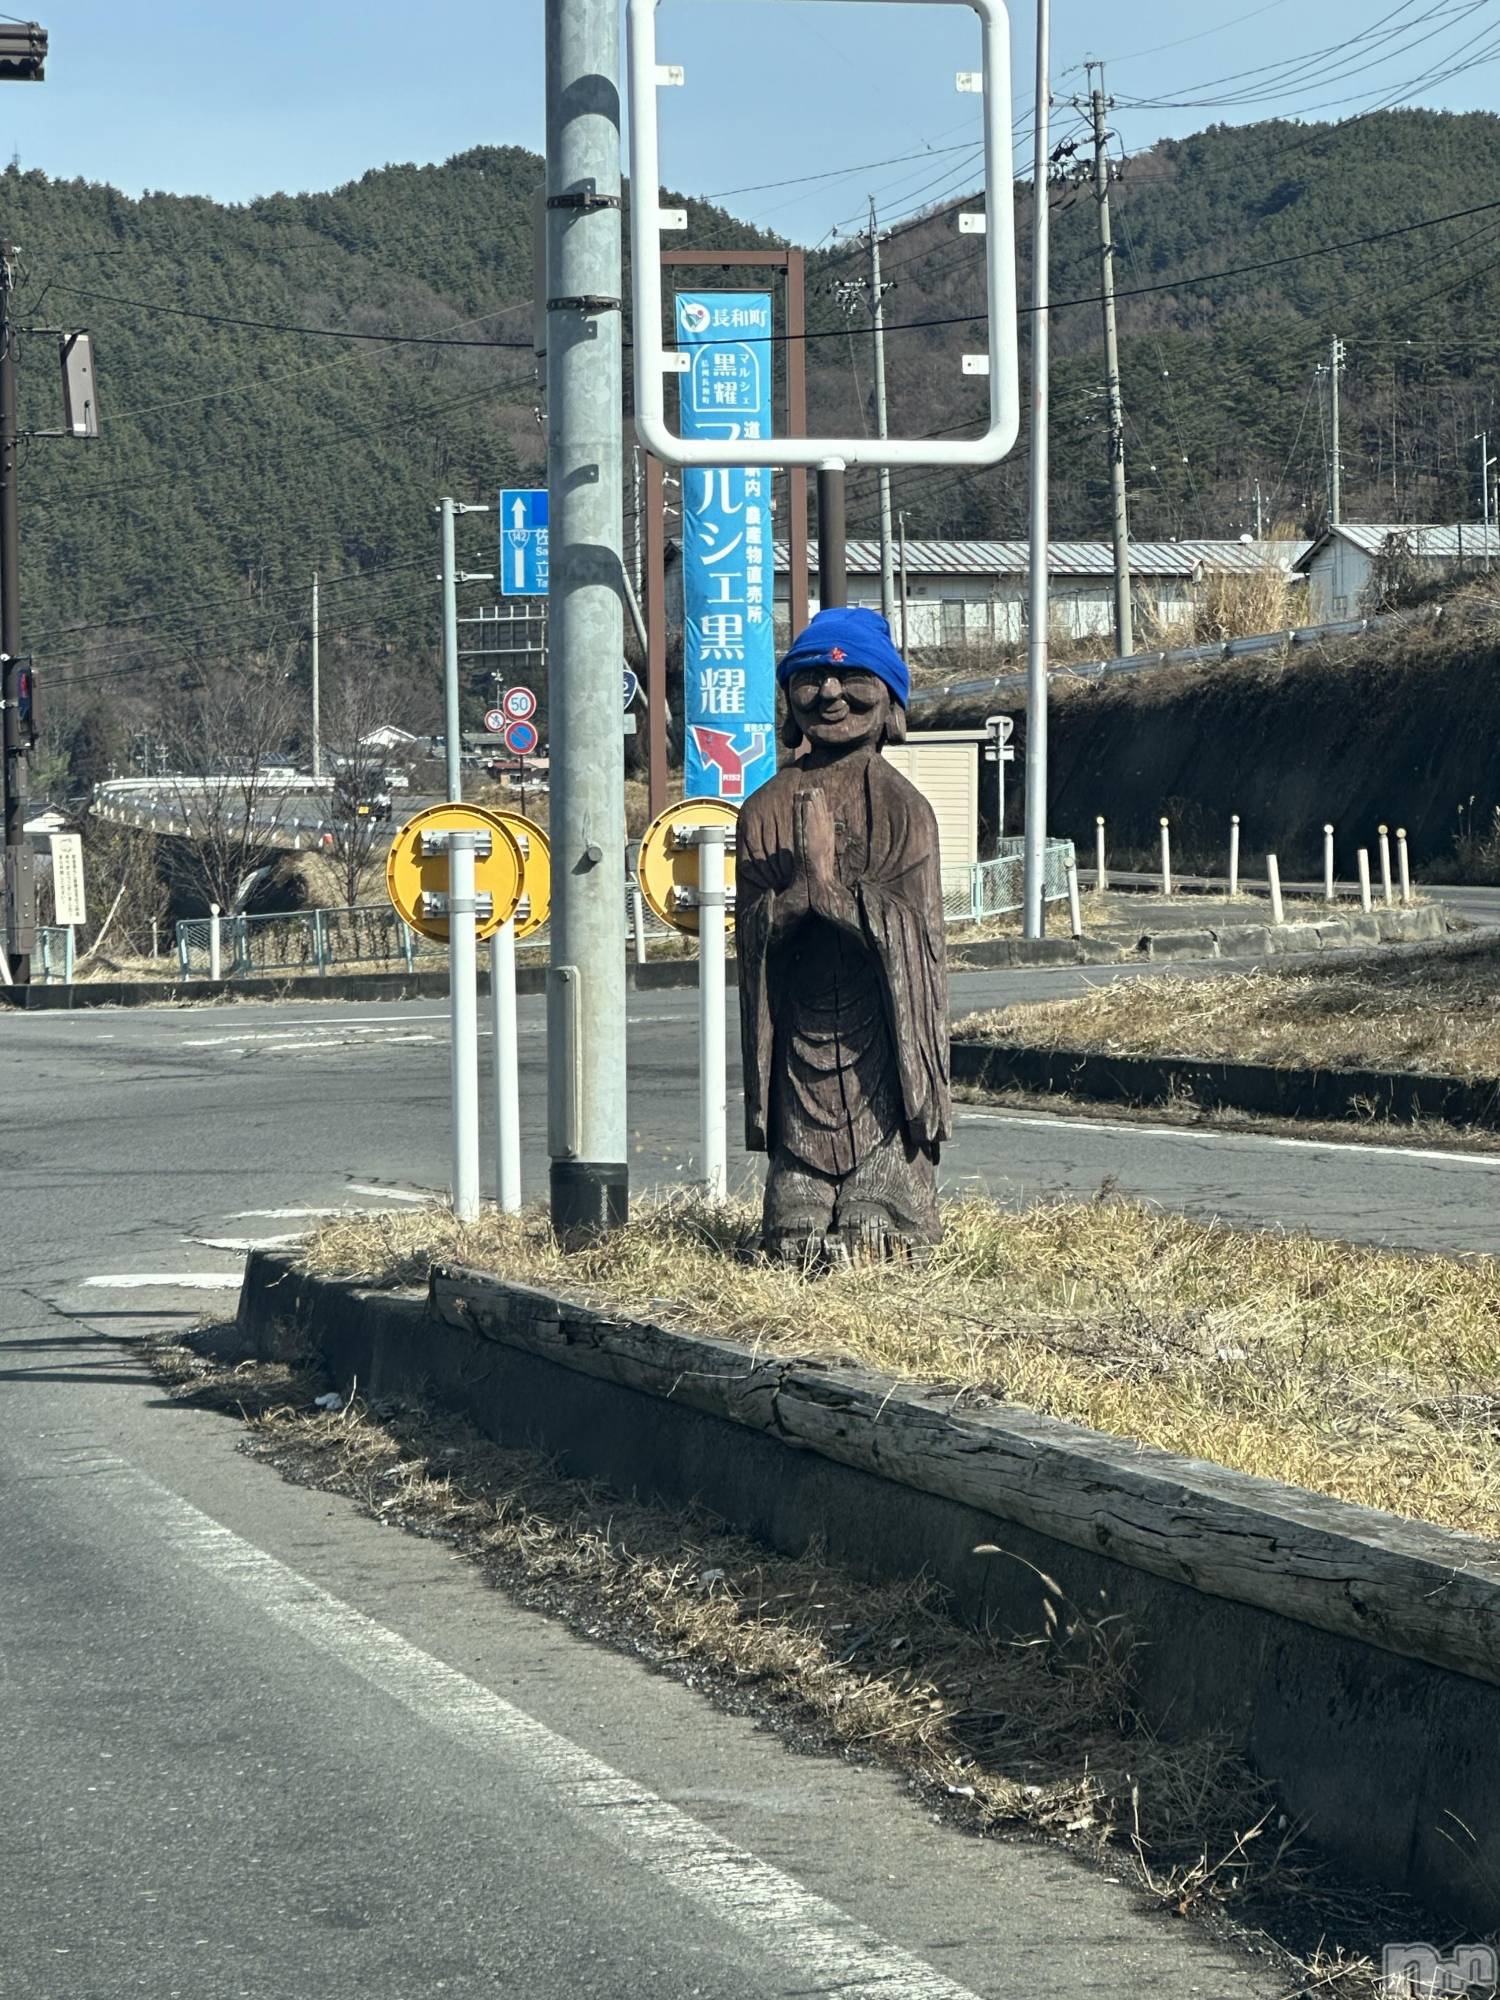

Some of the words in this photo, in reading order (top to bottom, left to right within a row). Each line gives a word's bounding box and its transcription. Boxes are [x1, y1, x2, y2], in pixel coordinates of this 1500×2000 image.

[712, 308, 768, 328] 長和町
[713, 353, 737, 405] 黒耀
[512, 532, 527, 541] 142
[510, 697, 529, 711] 50
